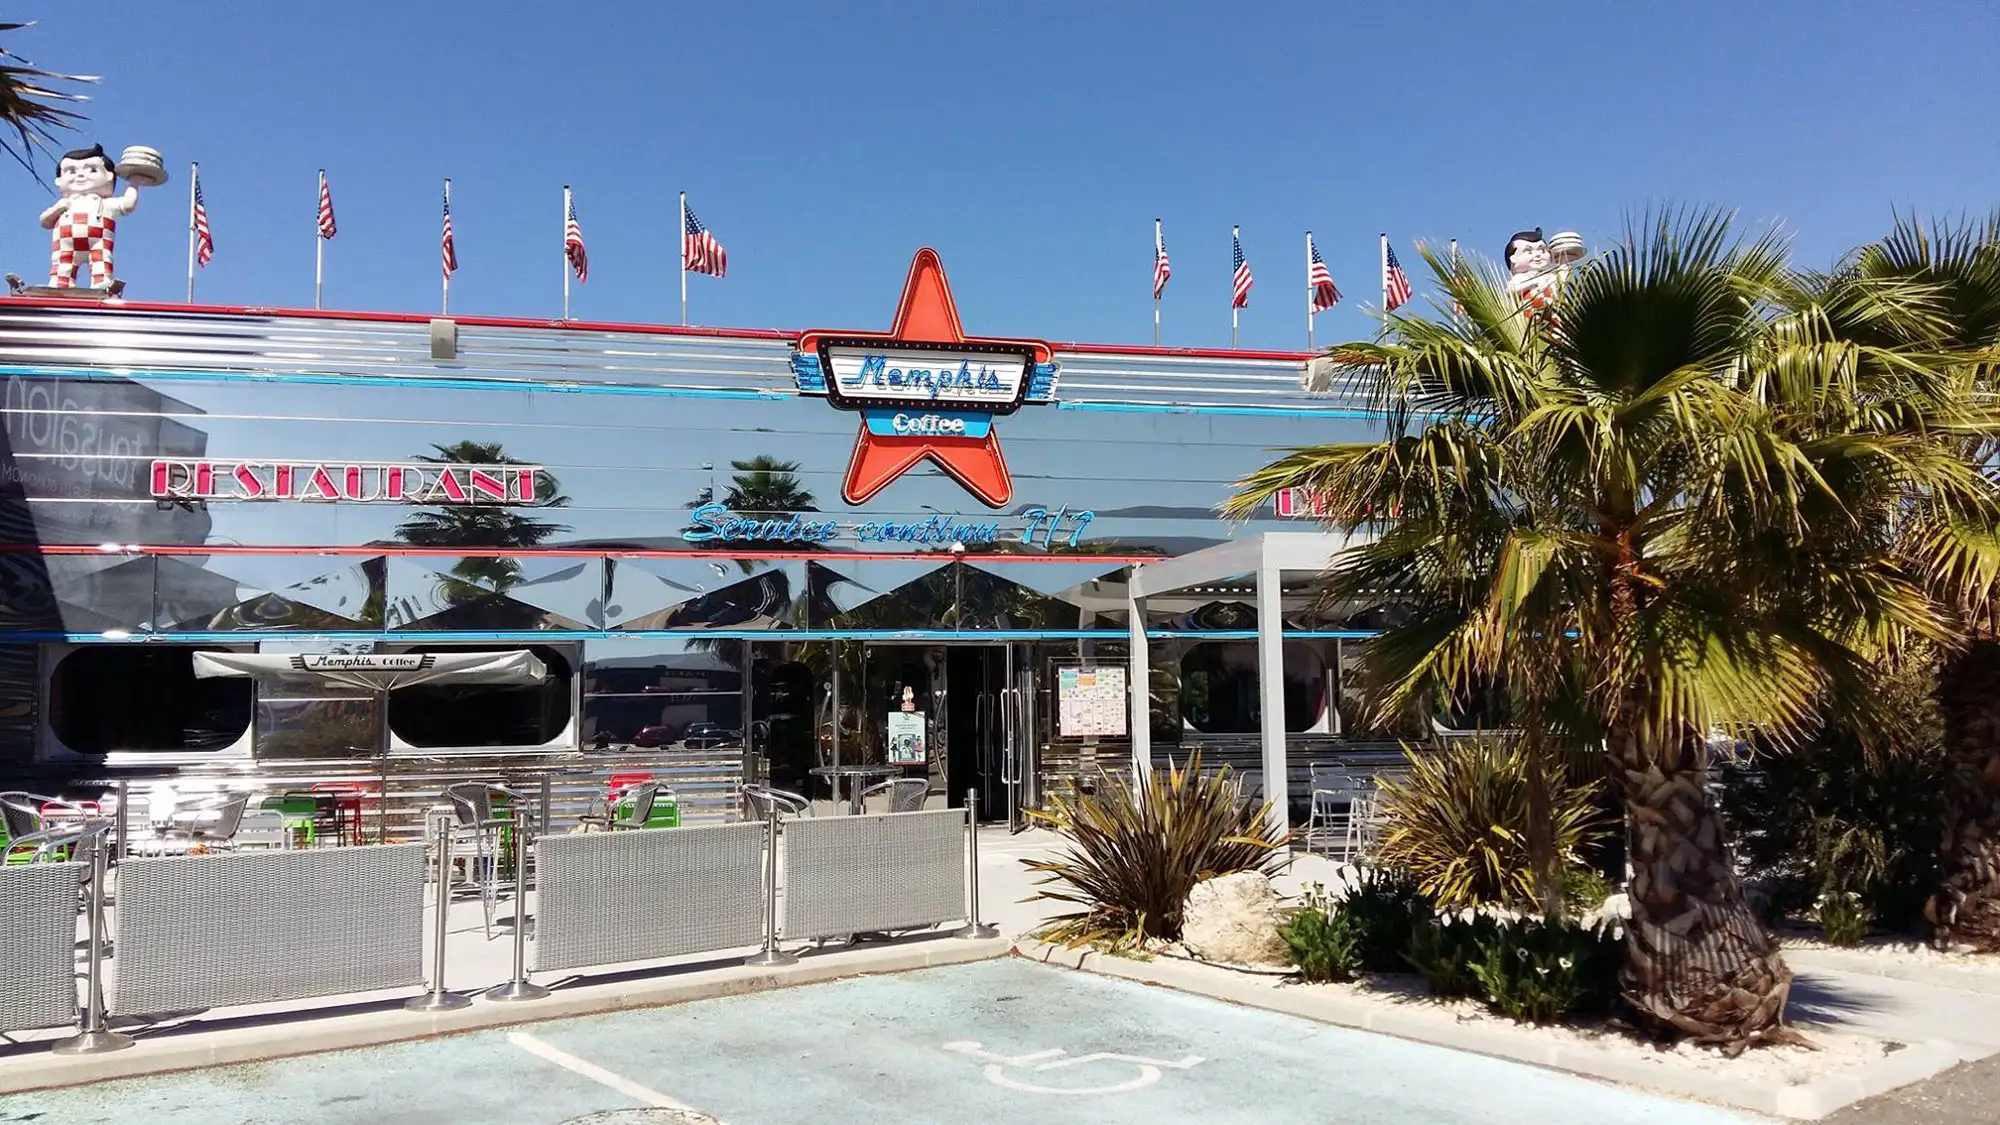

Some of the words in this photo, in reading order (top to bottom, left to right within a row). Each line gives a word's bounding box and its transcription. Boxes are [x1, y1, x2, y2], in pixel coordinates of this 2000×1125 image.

[841, 354, 1012, 400] Memphis
[892, 413, 966, 433] Coffee
[150, 459, 544, 502] RESTAURANT
[683, 501, 839, 543] Service
[857, 514, 999, 543] continu
[1020, 503, 1094, 548] 7/7
[310, 655, 377, 669] Memphis
[382, 658, 416, 666] Coffee
